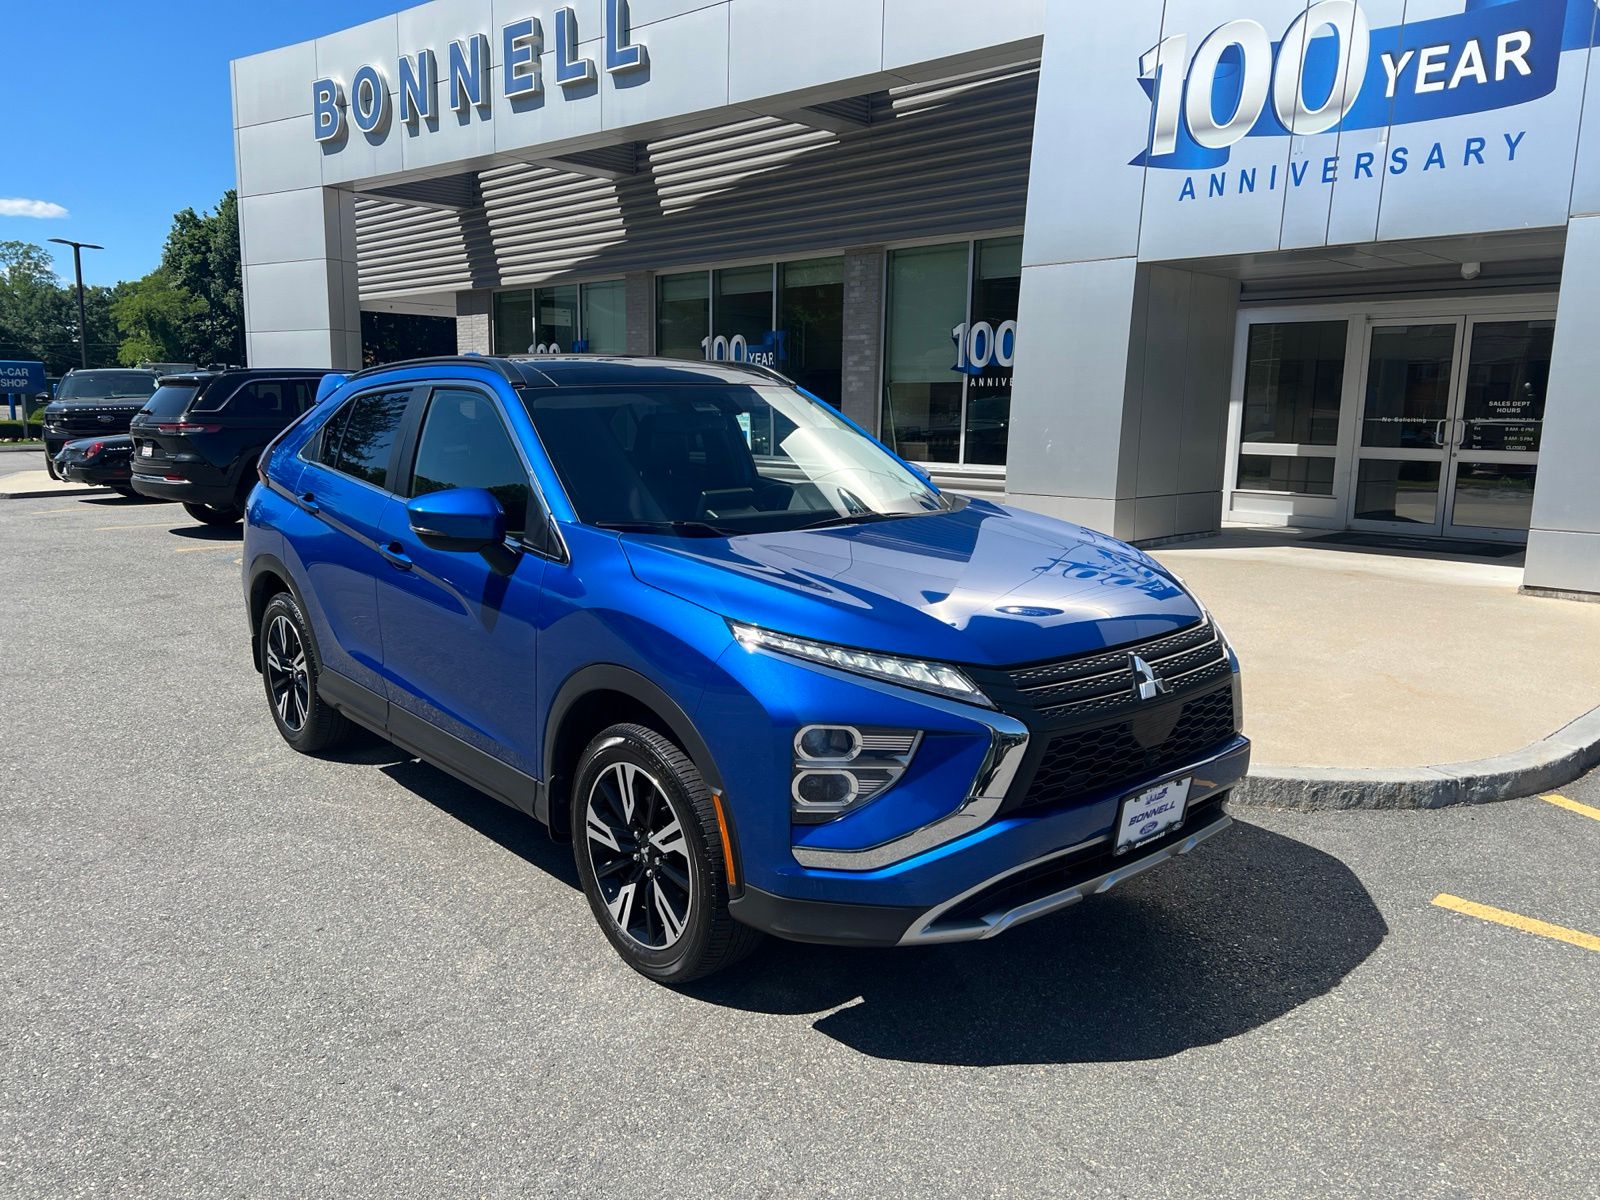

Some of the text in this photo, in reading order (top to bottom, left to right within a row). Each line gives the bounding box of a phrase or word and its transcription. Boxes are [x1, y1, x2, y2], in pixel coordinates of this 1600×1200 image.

[311, 0, 648, 142] BONNELL
[1138, 0, 1532, 156] 100 YEAR
[1178, 131, 1526, 201] ANNIVERSARY
[701, 334, 775, 366] 100 YEAR
[951, 320, 1017, 368] 100
[0, 378, 28, 387] SHOP
[1127, 800, 1176, 827] BONNELL
